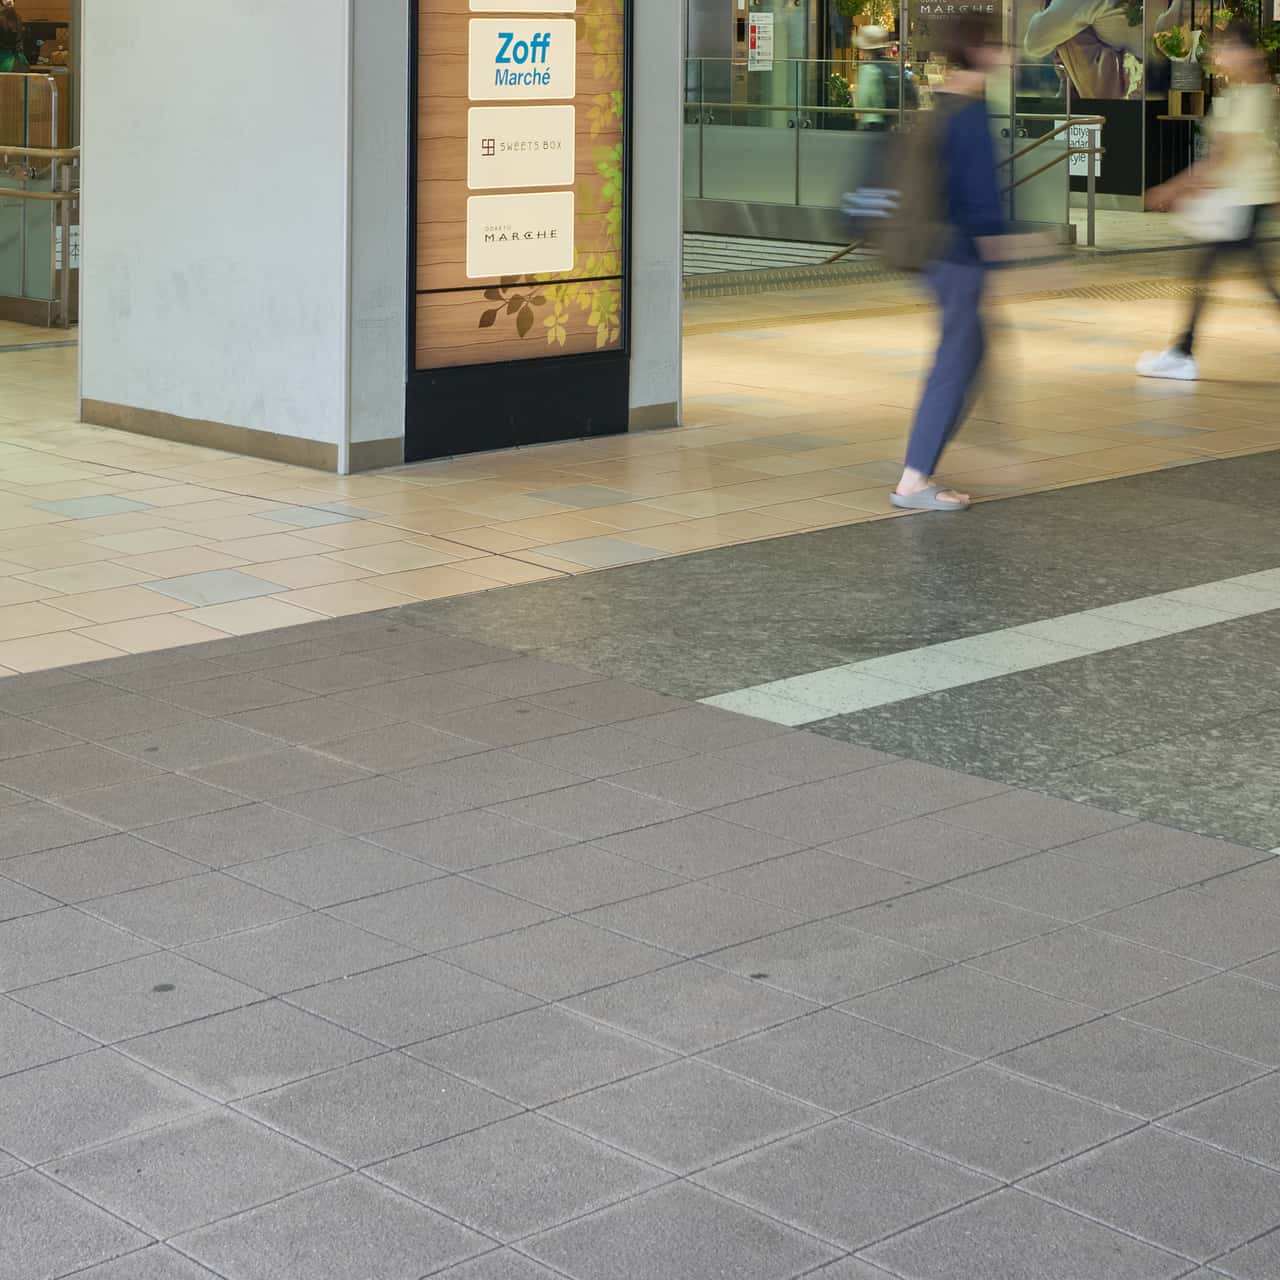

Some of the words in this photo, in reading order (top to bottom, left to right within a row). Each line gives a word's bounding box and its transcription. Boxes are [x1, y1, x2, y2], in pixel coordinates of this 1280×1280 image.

[495, 32, 551, 65] Zoff
[494, 67, 551, 86] Marché
[499, 141, 540, 152] SWEETS
[542, 140, 563, 151] BOX
[484, 229, 558, 243] MARCHE
